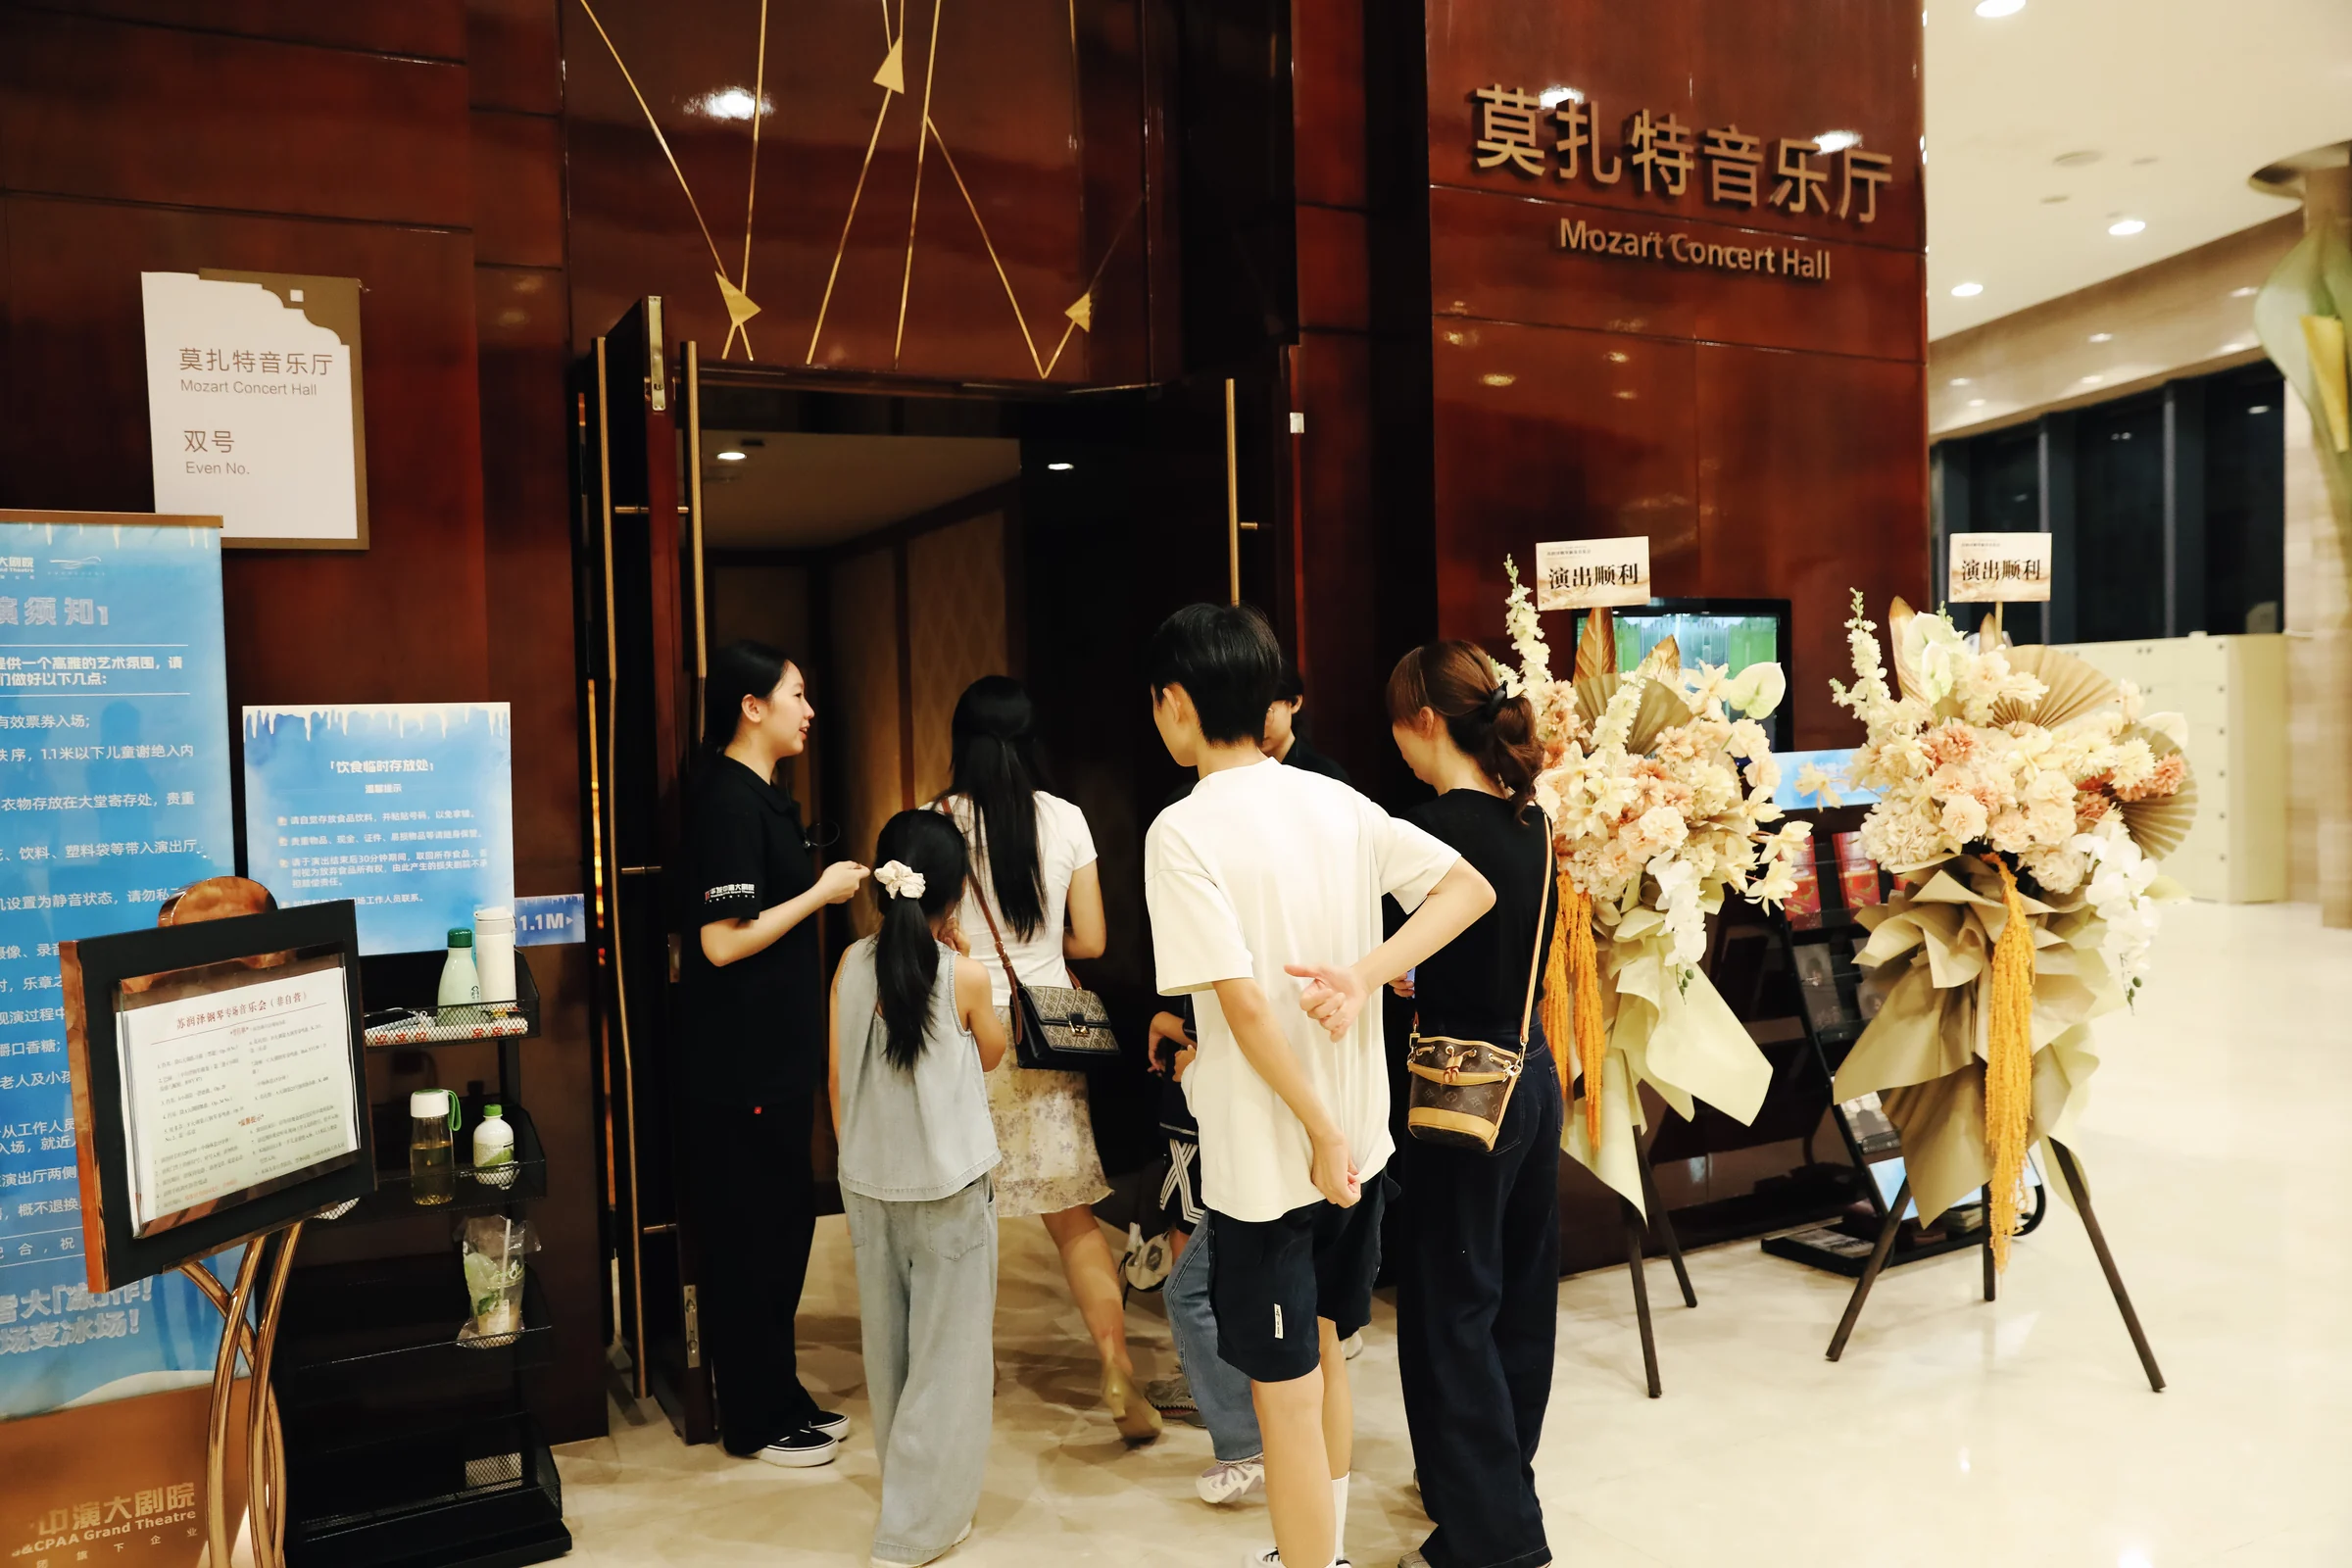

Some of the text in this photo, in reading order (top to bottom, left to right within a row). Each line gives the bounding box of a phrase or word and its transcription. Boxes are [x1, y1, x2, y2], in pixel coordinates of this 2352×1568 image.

[1476, 83, 1893, 223] 莫扎特音乐厅
[1560, 218, 1831, 280] Mozart Concert Hall
[179, 347, 332, 375] 莫扎特音乐厅
[180, 379, 317, 396] Mozart Concert Hall
[183, 429, 235, 454] 双号
[186, 461, 250, 475] Even No.
[1549, 563, 1639, 590] 演出顺利
[1962, 559, 2040, 581] 演出顺利
[0, 839, 197, 862] 、饮料、塑料袋等带入演出厅
[519, 913, 564, 932] 1.1M
[83, 1521, 131, 1542] Grand
[135, 1509, 196, 1531] Theatre
